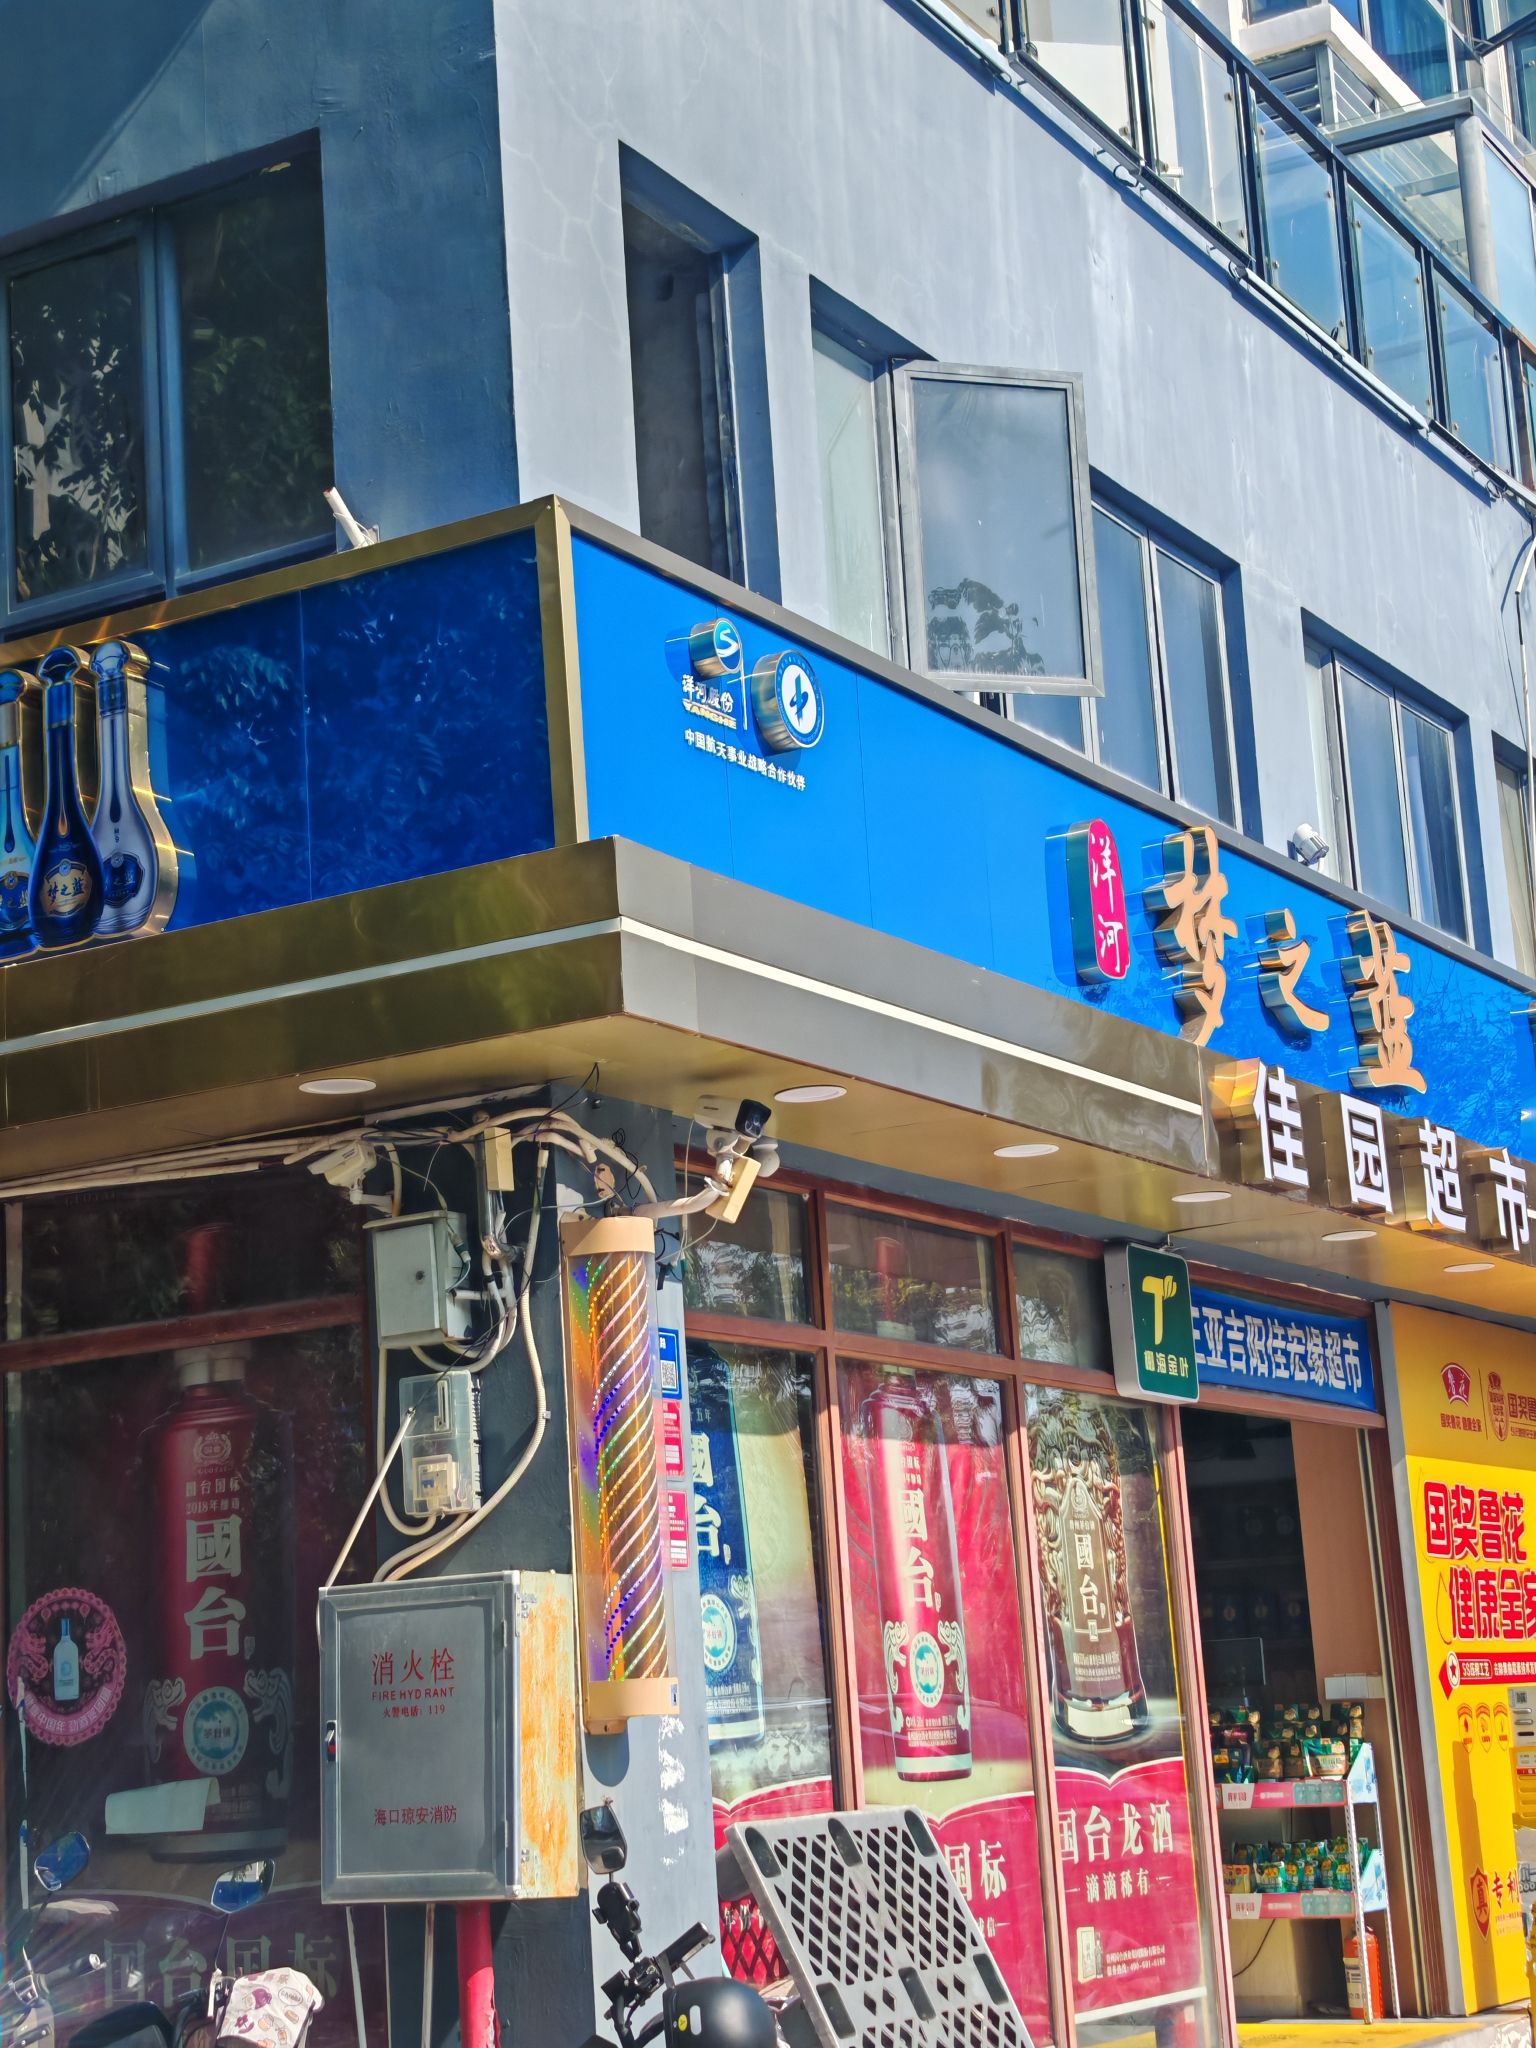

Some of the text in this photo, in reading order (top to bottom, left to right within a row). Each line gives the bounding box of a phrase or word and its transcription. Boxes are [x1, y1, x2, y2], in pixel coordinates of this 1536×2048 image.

[682, 674, 733, 713] 洋河股份
[684, 728, 806, 792] 中国航天事业战略合作伙伴
[1091, 832, 1125, 972] 洋河
[1163, 825, 1427, 1094] 梦之蓝
[1253, 1062, 1530, 1251] 佳园超市
[1424, 1481, 1528, 1562] 国奖鲁花
[184, 1513, 247, 1660] 國台
[371, 1647, 455, 1686] 消火栓
[372, 1686, 455, 1703] FIRE HYDRANT
[428, 1703, 446, 1716] 119
[373, 1804, 457, 1827] 海口琼安消防
[1058, 1799, 1174, 1865] 国台龙酒
[1086, 1867, 1150, 1903] 滴滴稀有
